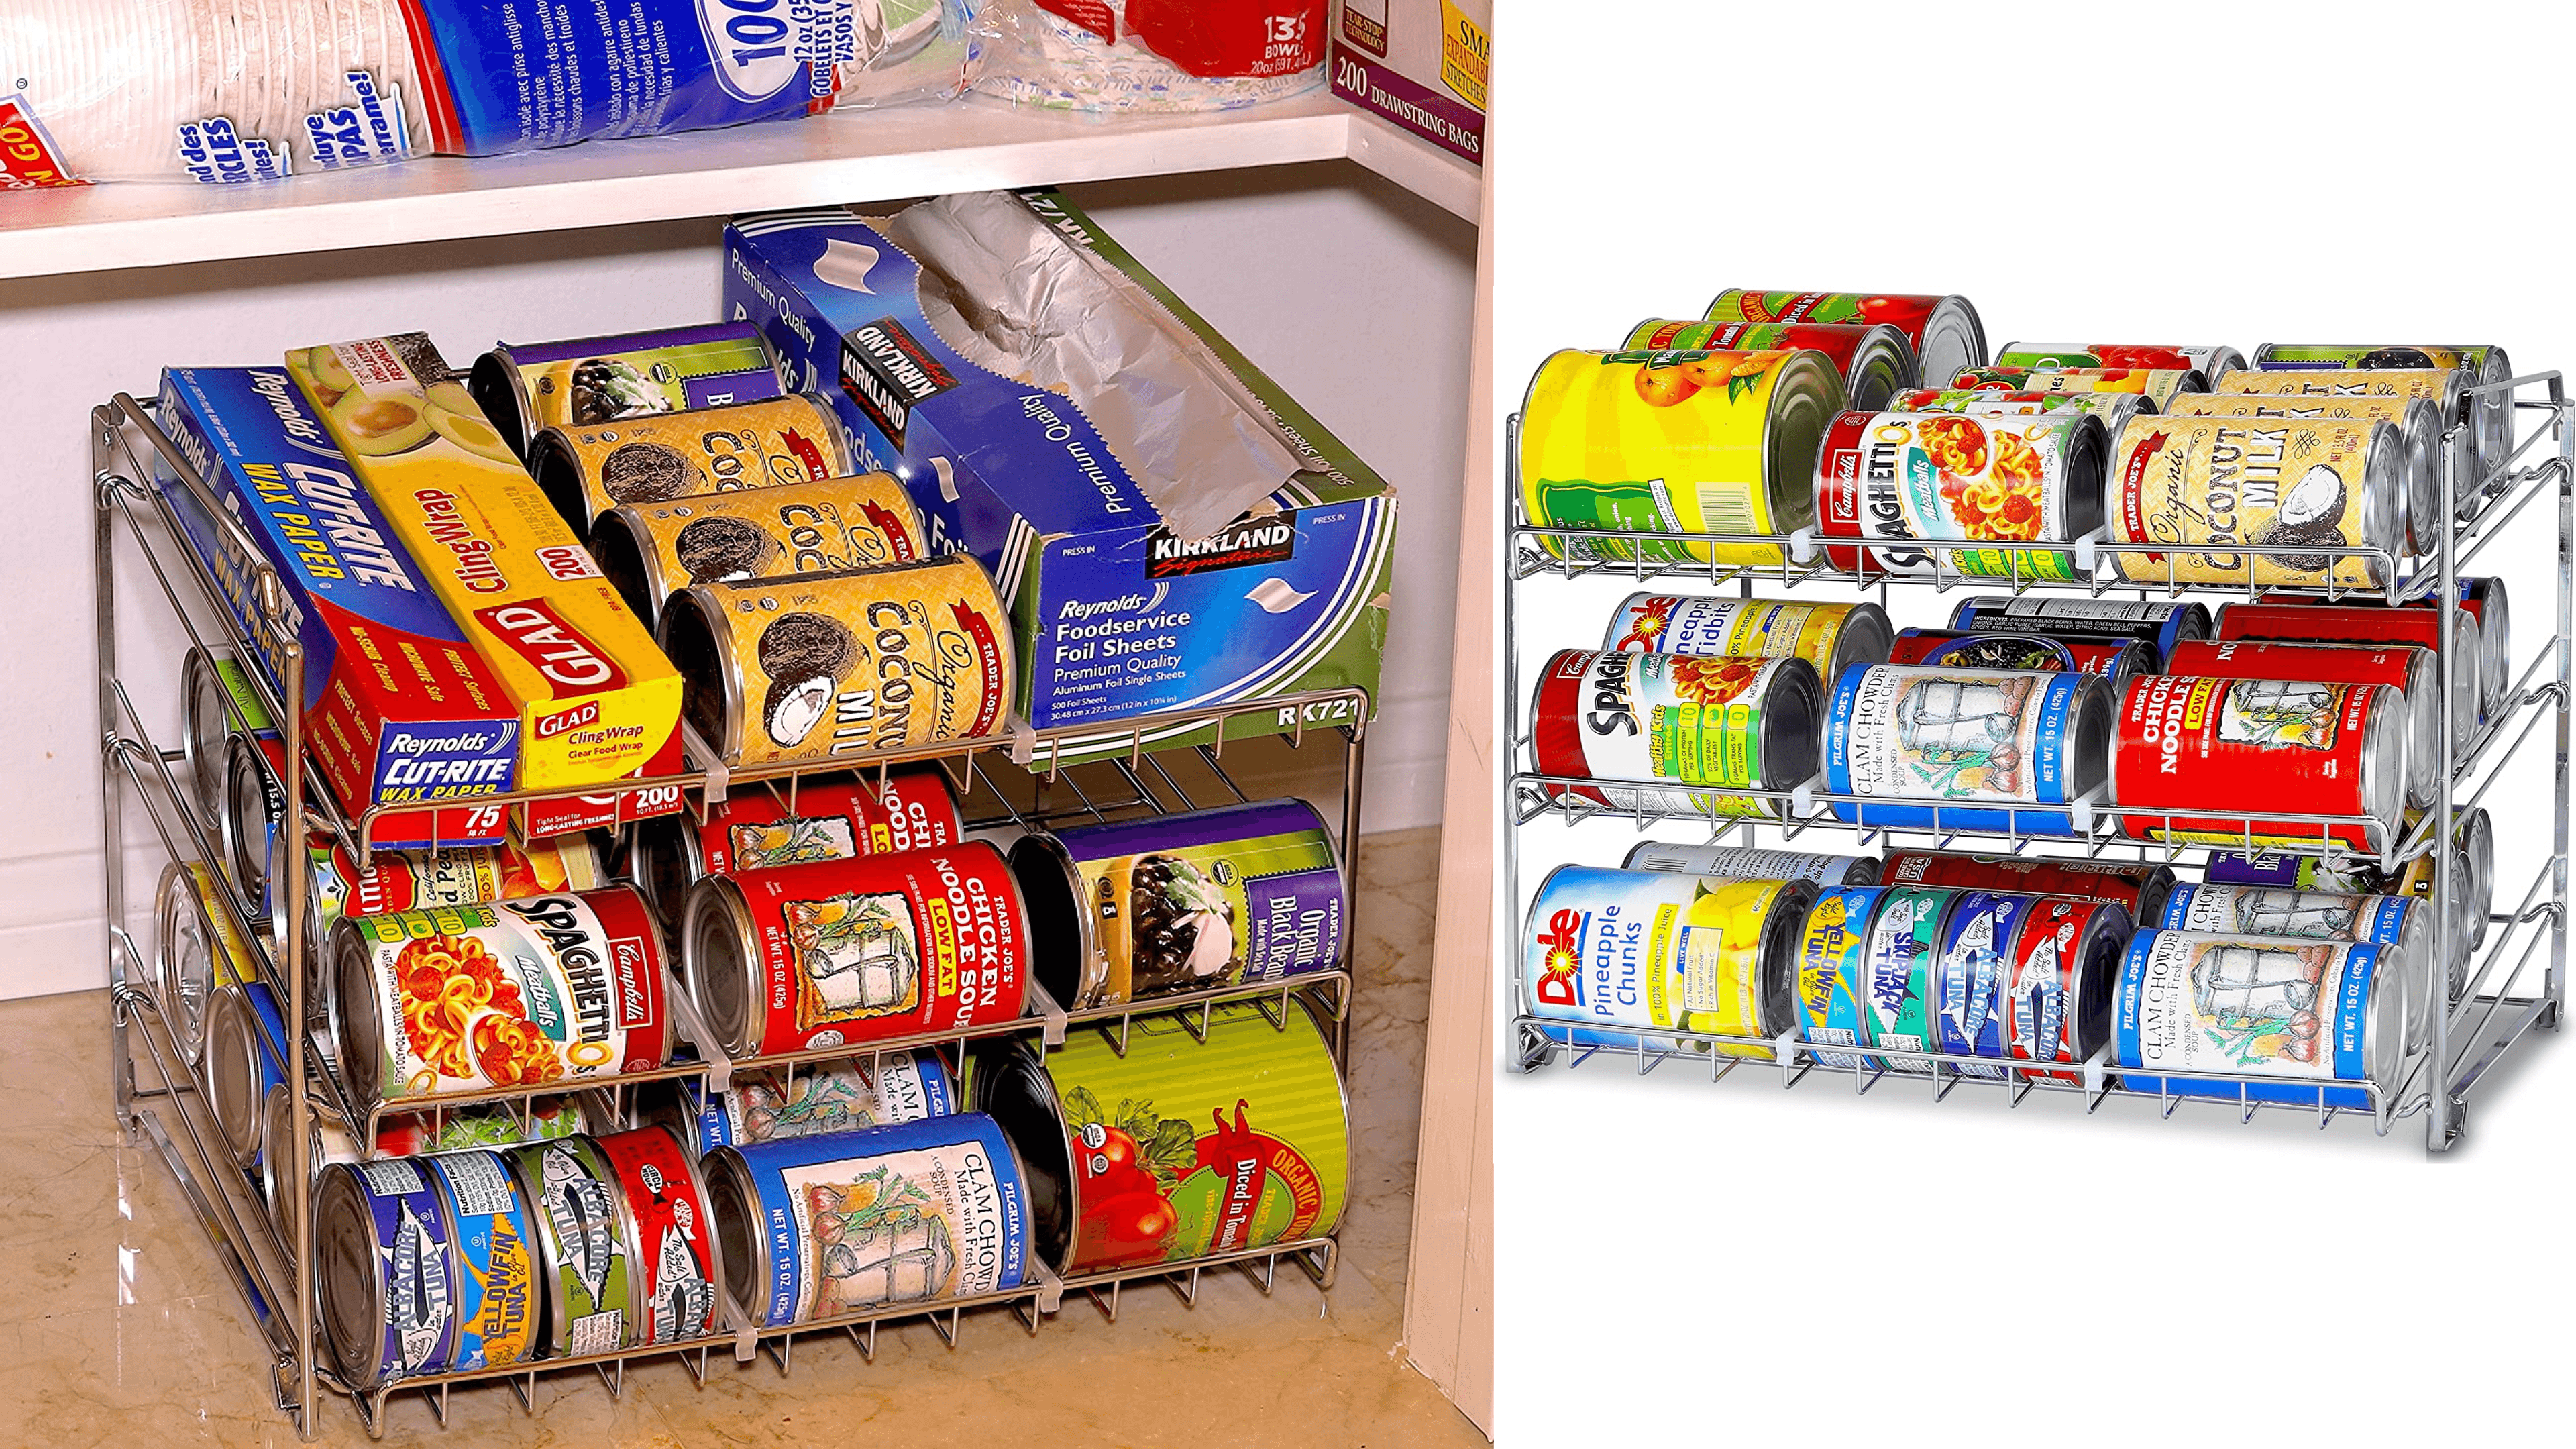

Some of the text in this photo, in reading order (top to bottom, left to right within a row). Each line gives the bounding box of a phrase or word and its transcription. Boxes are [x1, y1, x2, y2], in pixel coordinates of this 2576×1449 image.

[503, 3, 523, 50] antiglisse
[836, 3, 853, 11] Y
[1346, 21, 1384, 52] TECHNOLOGY
[555, 4, 581, 95] chaudes froides
[606, 39, 622, 91] con agarre
[618, 19, 641, 78] poliestireno
[629, 1, 656, 101] necesidad fundas
[653, 19, 670, 64] calientes
[794, 26, 813, 62] 12 oz
[810, 10, 833, 97] GOBELETS ET
[535, 75, 551, 133] polystyrène
[545, 42, 566, 108] nécessité des
[1337, 57, 1367, 96] 200
[1371, 85, 1446, 137] DRAWSTRING
[1448, 123, 1479, 153] BAGS
[1447, 62, 1486, 104] STRETCHES
[732, 248, 775, 309] Premium
[778, 296, 816, 352] Quality
[842, 350, 905, 431] KIRKLAND
[856, 325, 937, 401] KIRKLAND
[160, 389, 208, 478] Reynolds
[247, 369, 323, 445] Reynolds
[1019, 393, 1132, 513] Premium Quality
[2242, 428, 2290, 508] MILK
[1836, 454, 1857, 519] Campbell's
[1919, 459, 1939, 522] Meatballs
[2128, 490, 2140, 532] TRADER
[240, 462, 300, 506] WAX
[270, 511, 345, 580] PAPER
[413, 488, 472, 543] Wrap
[450, 538, 508, 594] Cling
[1062, 546, 1086, 556] PRESS
[541, 547, 588, 579] 200
[1055, 610, 1191, 643] Foodservice
[1058, 594, 1146, 621] Reynolds
[494, 606, 612, 687] GLAD
[1053, 653, 1182, 684] Premium Quality
[1055, 633, 1177, 665] Foil Sheets
[912, 631, 973, 740] Organic
[981, 643, 1003, 727] TRADER JOE'S
[1052, 697, 1107, 710] 500 Foil Sheets
[1053, 670, 1187, 696] Aluminum Foil Single Sheets
[2131, 689, 2149, 722] TRADER
[2189, 694, 2205, 723] LOW
[387, 733, 489, 758] Reynolds
[539, 703, 597, 735] GLAD
[568, 724, 644, 745] Cling Wrap
[1051, 711, 1071, 720] 30.48
[1650, 704, 1666, 732] Kids
[1833, 692, 1850, 766] PILGRIM JOE'S
[1856, 667, 1890, 794] CLAM CHOWDER
[1873, 674, 1899, 783] Made with Fresh Clams
[2043, 688, 2068, 782] NET WT. 15 (425g)
[2161, 685, 2192, 774] NOODLE
[568, 749, 592, 759] Clear
[594, 745, 617, 755] Food
[620, 742, 643, 751] Wrap
[1891, 749, 1900, 794] CONDENSED
[380, 787, 425, 801] WAX
[465, 805, 502, 830] 75
[536, 814, 570, 826] Tight Seal
[636, 786, 679, 808] 200
[930, 858, 977, 963] NOODLE
[965, 877, 998, 1006] CHICKEN
[994, 896, 1012, 947] TRADER
[1269, 895, 1297, 946] Black
[1294, 909, 1326, 967] Organic
[1327, 898, 1339, 940] TRADER
[1681, 932, 1689, 948] WELL
[765, 926, 787, 1010] NET 15 OZ (425g)
[930, 901, 955, 991] LOW FAT
[1537, 908, 1582, 1006] Dole
[1593, 905, 1621, 1016] Pineapple
[1617, 922, 1642, 1006] Chunks
[1652, 908, 1672, 1010] 100% Pineapple Juice
[1802, 928, 1827, 972] TUNA
[1815, 922, 1847, 1018] YELLOWFIN
[1874, 947, 1894, 1000] TUNA
[1880, 932, 1913, 1013] SKIPJACK
[515, 955, 556, 1027] Meatballs
[1947, 961, 1966, 1010] TUNA
[1965, 947, 2000, 1036] ALBACORE
[2123, 955, 2142, 1030] PILGRIM JOE'S
[2147, 932, 2182, 1059] CLAM CHOWDER
[2165, 939, 2192, 1048] Made with Fresh Clams
[2343, 957, 2369, 1052] NET WT. 15 (425g)
[2015, 995, 2035, 1043] TUNA
[965, 1154, 994, 1214] CLAM
[1235, 1157, 1256, 1199] Diced
[1272, 1149, 1319, 1210] ORGANIC
[556, 1201, 583, 1258] TUNA
[573, 1178, 612, 1283] ALBACORE
[772, 1209, 790, 1277] NET 15
[955, 1170, 977, 1269] Made with Fresh
[1003, 1181, 1020, 1270] PILGRIM JOE'S
[392, 1221, 418, 1331] ALBACORE
[423, 1250, 446, 1311] TUNA
[483, 1232, 518, 1343] YELLOWFIN
[500, 1282, 527, 1340] TUNA
